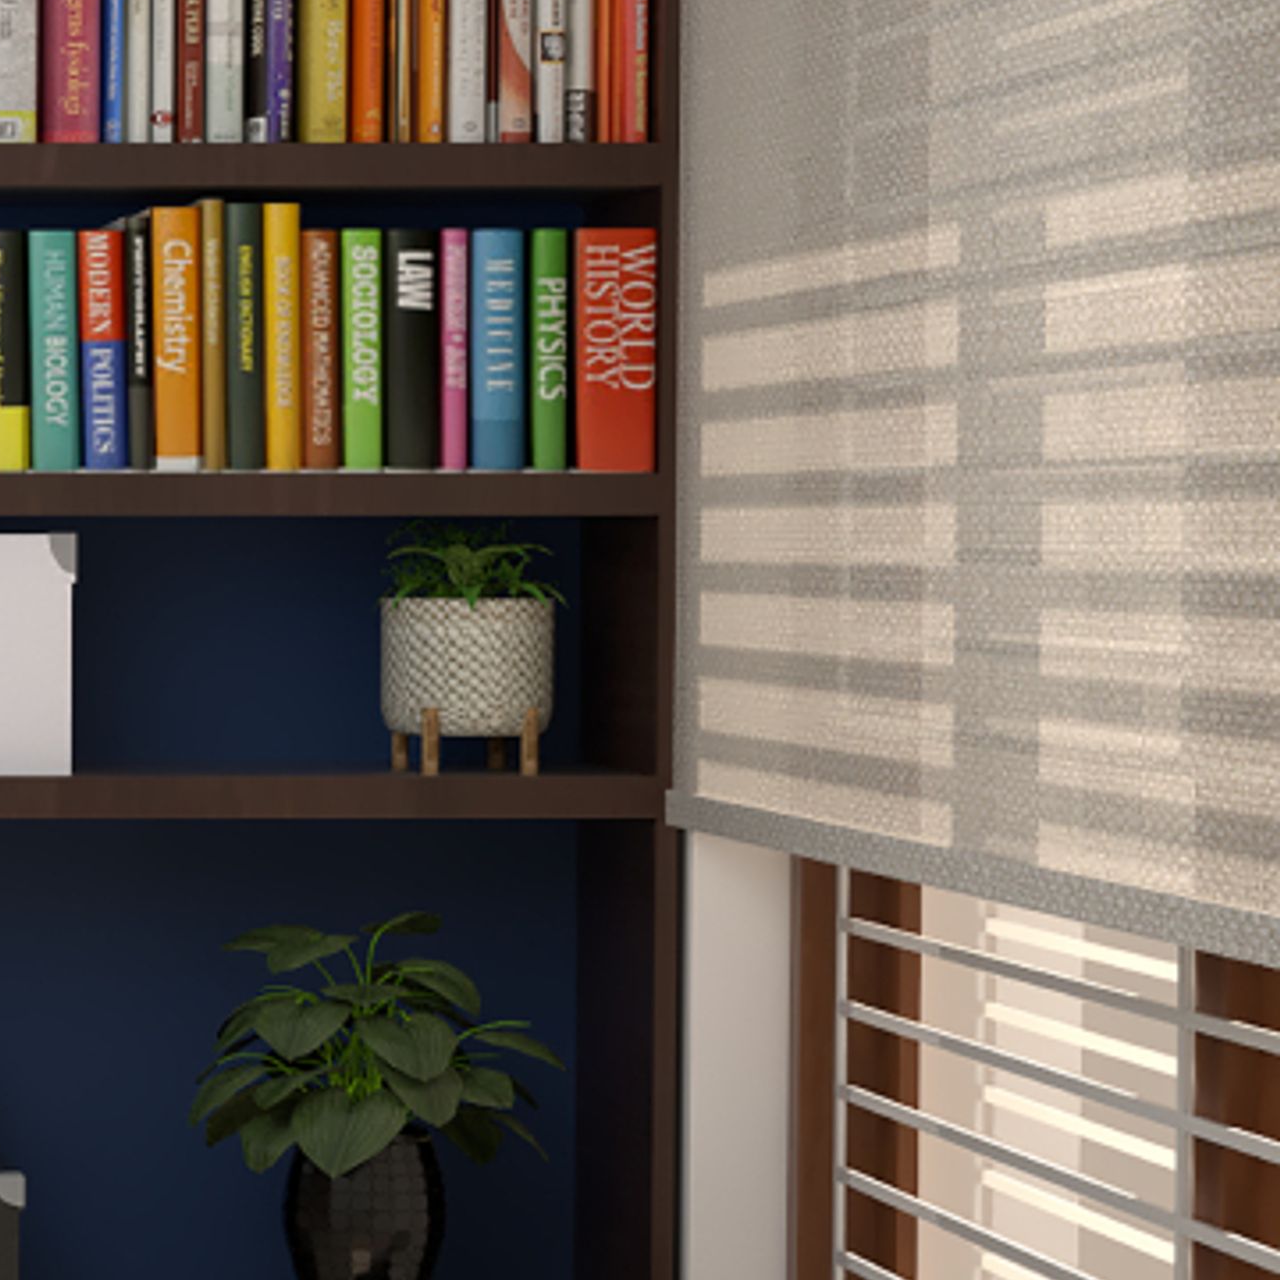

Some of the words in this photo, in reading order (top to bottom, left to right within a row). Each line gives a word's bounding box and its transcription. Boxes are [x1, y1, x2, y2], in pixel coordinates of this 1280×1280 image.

[43, 249, 68, 333] HUMAN
[86, 233, 114, 334] MODERN
[156, 239, 193, 374] Chemistry
[239, 245, 254, 296] ENGLISH
[312, 239, 333, 328] ADVANCED
[396, 251, 434, 311] LAW
[584, 244, 620, 389] HISTORY
[619, 244, 656, 390] WORLD
[239, 299, 254, 373] DICTIONARY
[352, 245, 378, 406] SOCIOLOGY
[486, 258, 515, 392] MEDICINE
[537, 277, 566, 401] PHYSICS
[43, 335, 68, 427] BIOLOGY
[90, 347, 116, 455] POLITICS
[312, 331, 333, 446] MATHEMATICS
